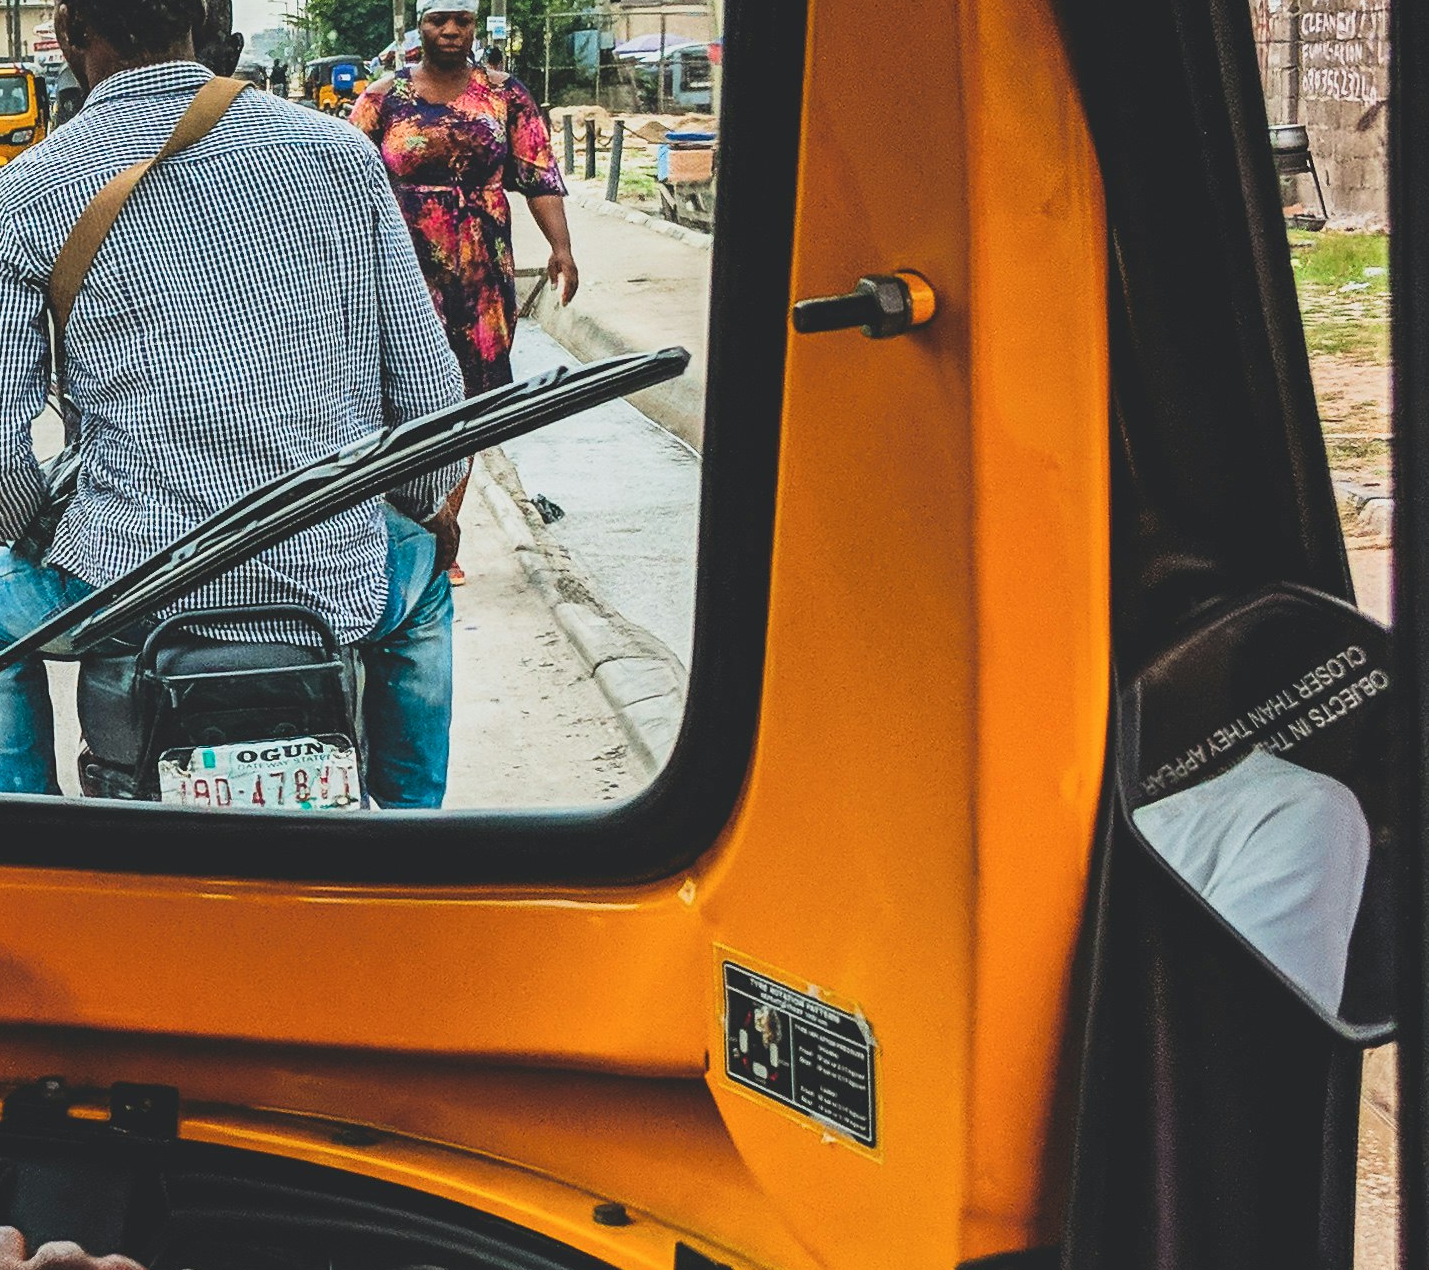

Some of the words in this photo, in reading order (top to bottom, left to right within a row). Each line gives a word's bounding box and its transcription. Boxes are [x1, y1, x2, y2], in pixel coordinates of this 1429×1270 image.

[1292, 645, 1368, 699] CLOSER
[1247, 688, 1299, 730] THAN
[1309, 668, 1391, 729] OBJECTS
[1205, 717, 1252, 757] THEY
[1287, 716, 1314, 740] IN
[236, 742, 325, 764] OGUN
[1140, 743, 1205, 796] APPEAR
